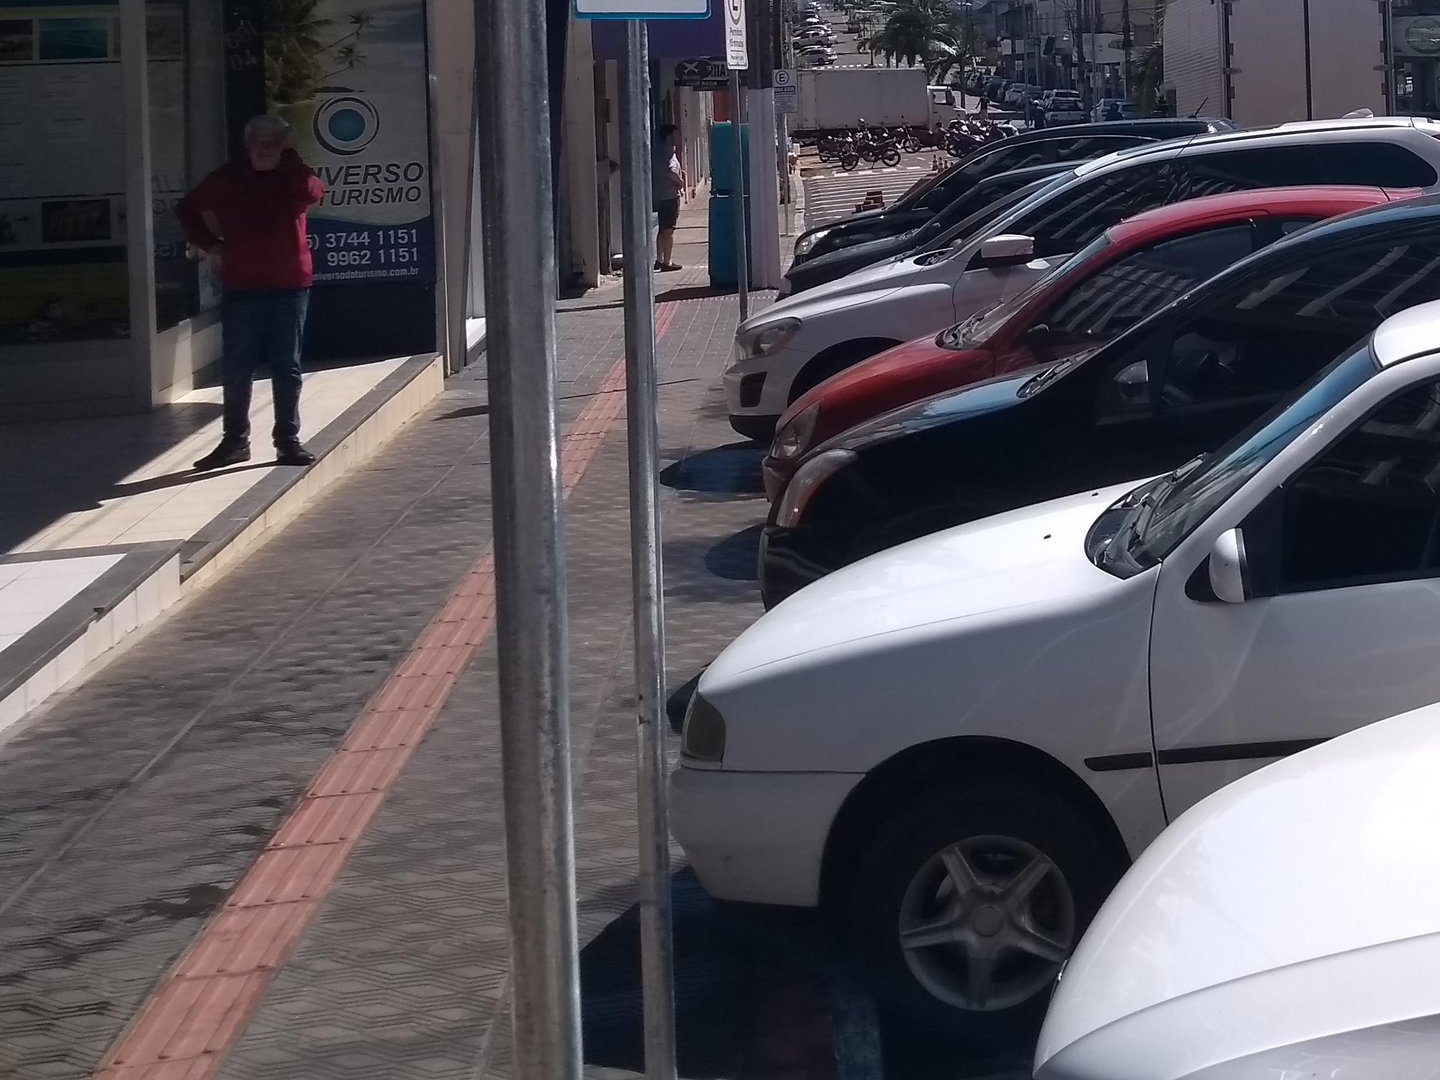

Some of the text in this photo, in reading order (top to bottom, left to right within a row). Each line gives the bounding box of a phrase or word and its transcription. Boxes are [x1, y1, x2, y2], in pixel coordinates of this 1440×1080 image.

[779, 73, 786, 82] E
[312, 162, 424, 186] IVERSO
[325, 231, 371, 248] 3744
[377, 228, 417, 245] 1151
[327, 247, 418, 266] 9962 1151
